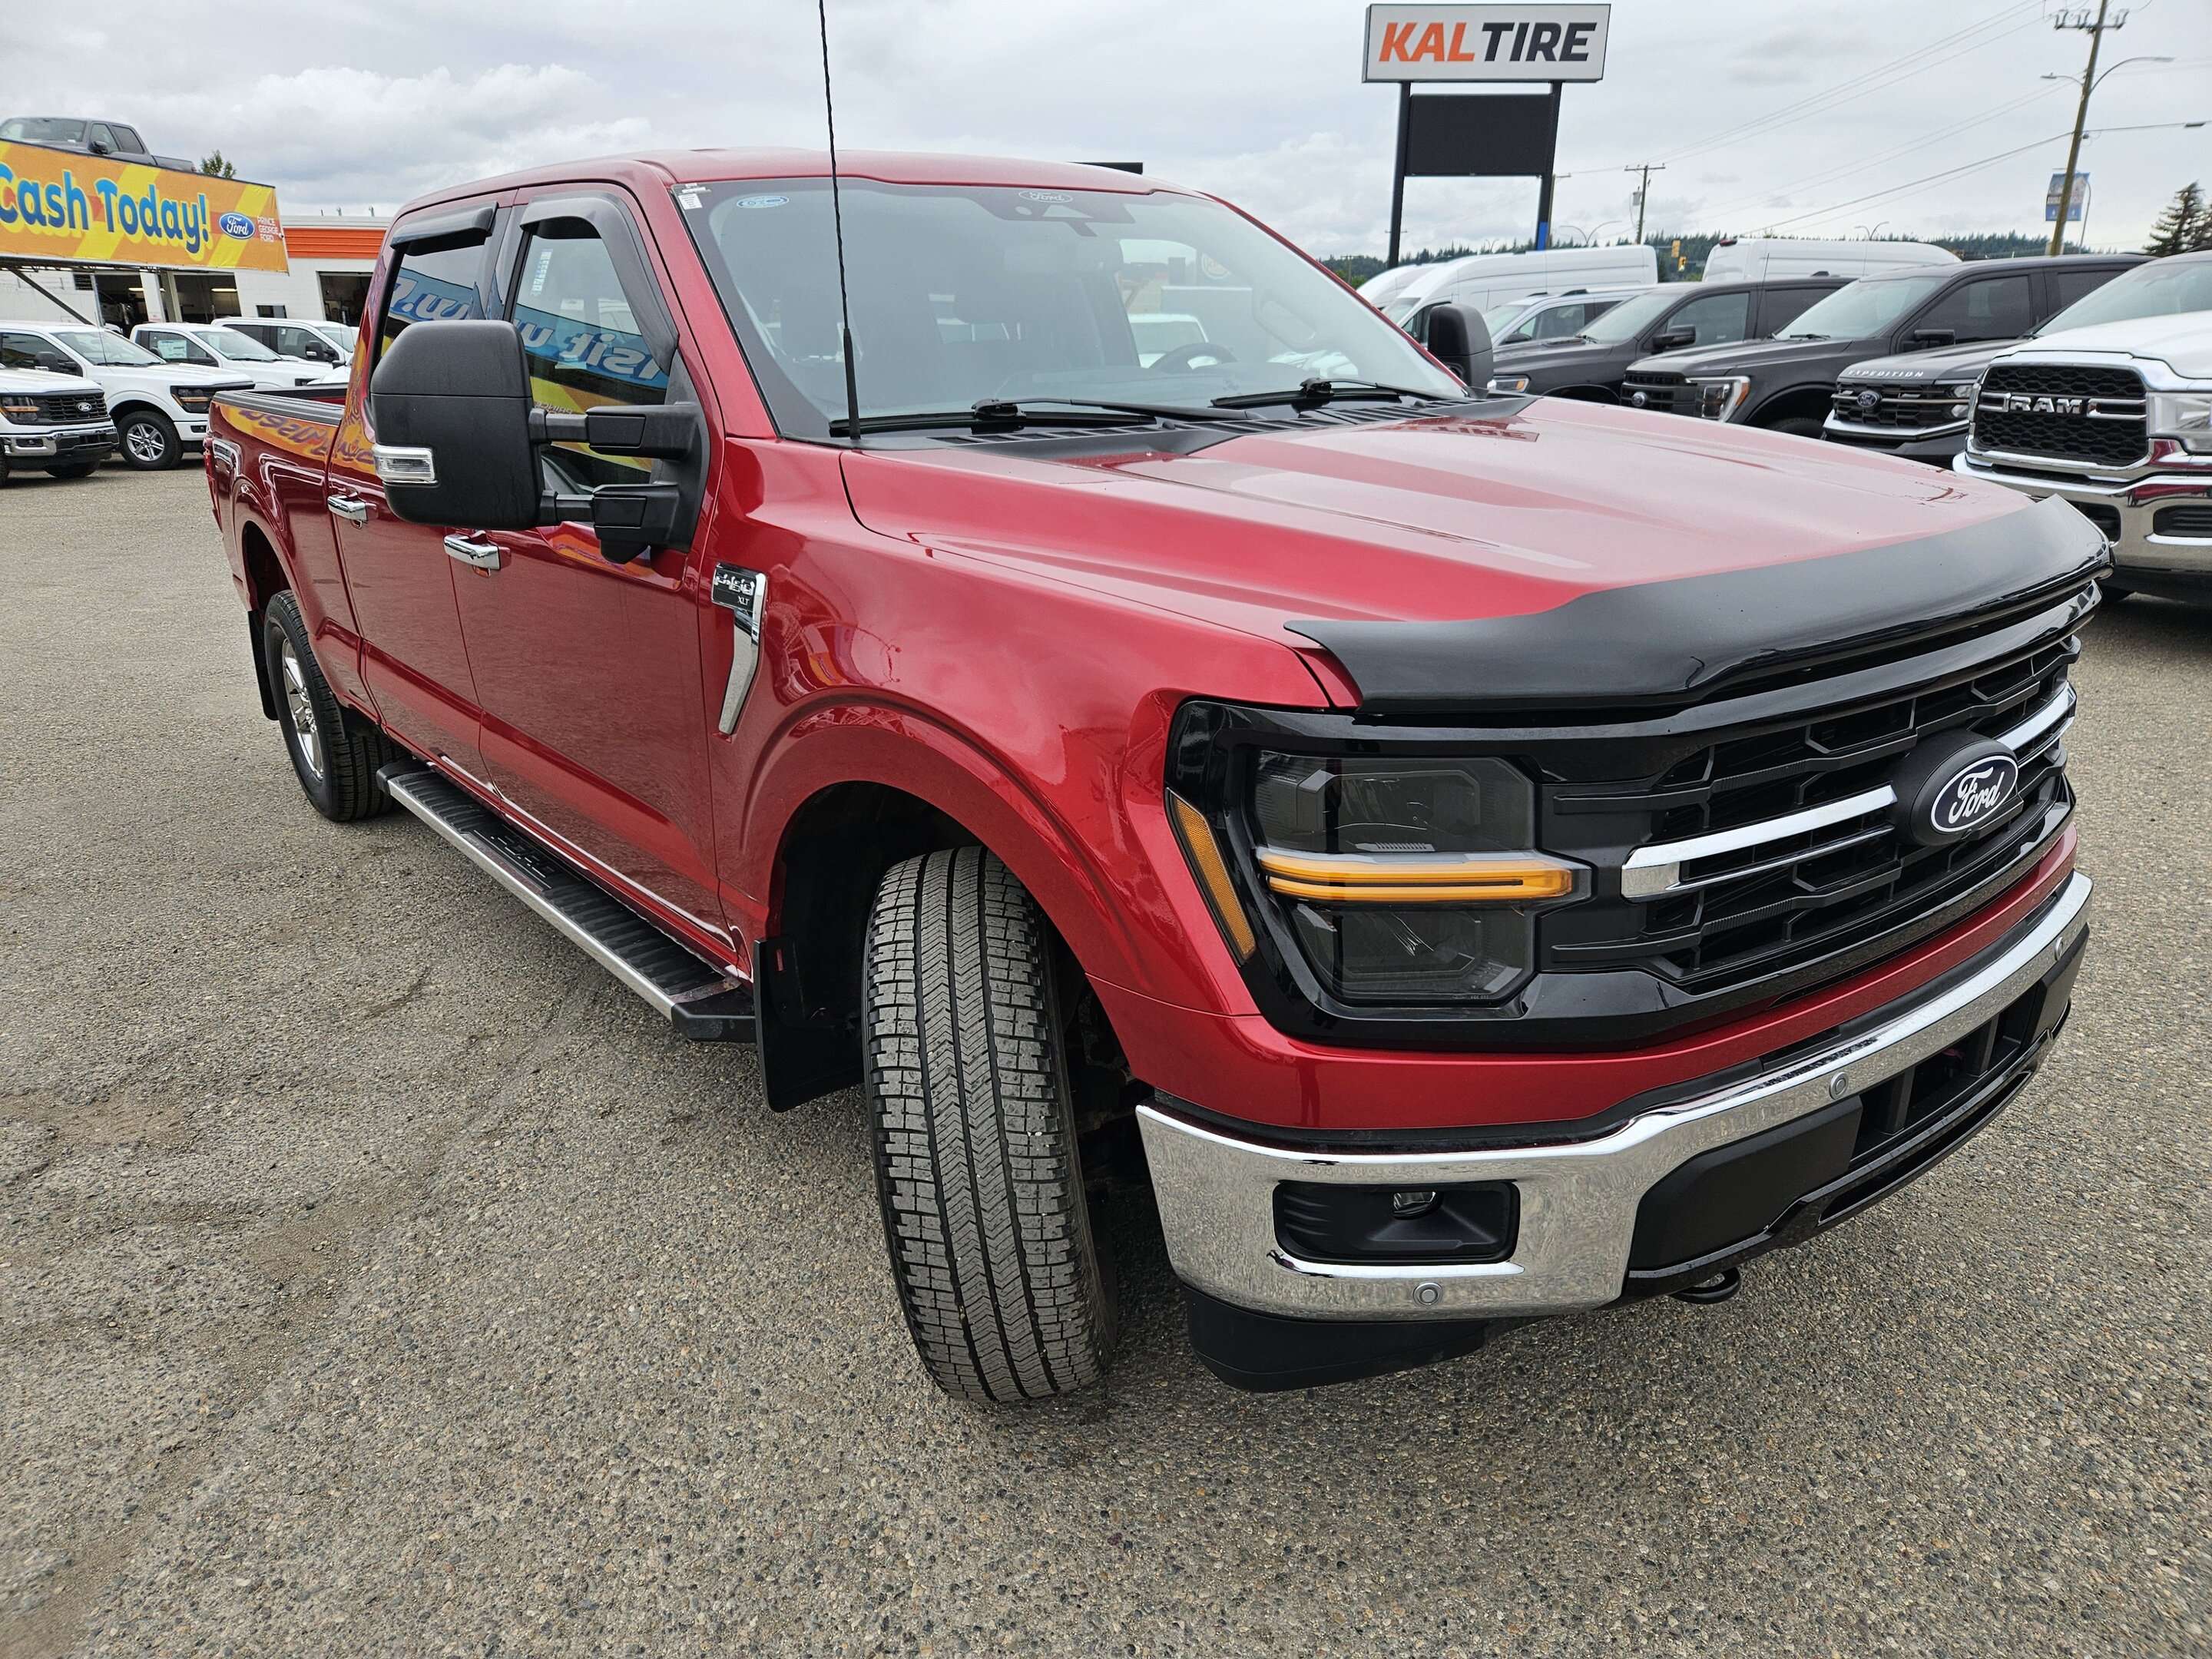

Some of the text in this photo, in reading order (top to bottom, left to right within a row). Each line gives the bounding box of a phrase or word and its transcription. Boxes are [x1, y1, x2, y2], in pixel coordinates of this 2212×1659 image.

[1379, 22, 1597, 62] KAL TIRE
[0, 162, 209, 253] Cash Today!
[257, 216, 276, 226] PRINCE
[258, 225, 279, 235] GEORGE
[260, 233, 274, 242] FORD
[2010, 396, 2083, 414] RAM
[738, 595, 750, 606] XLT
[1948, 767, 2005, 824] Ford
